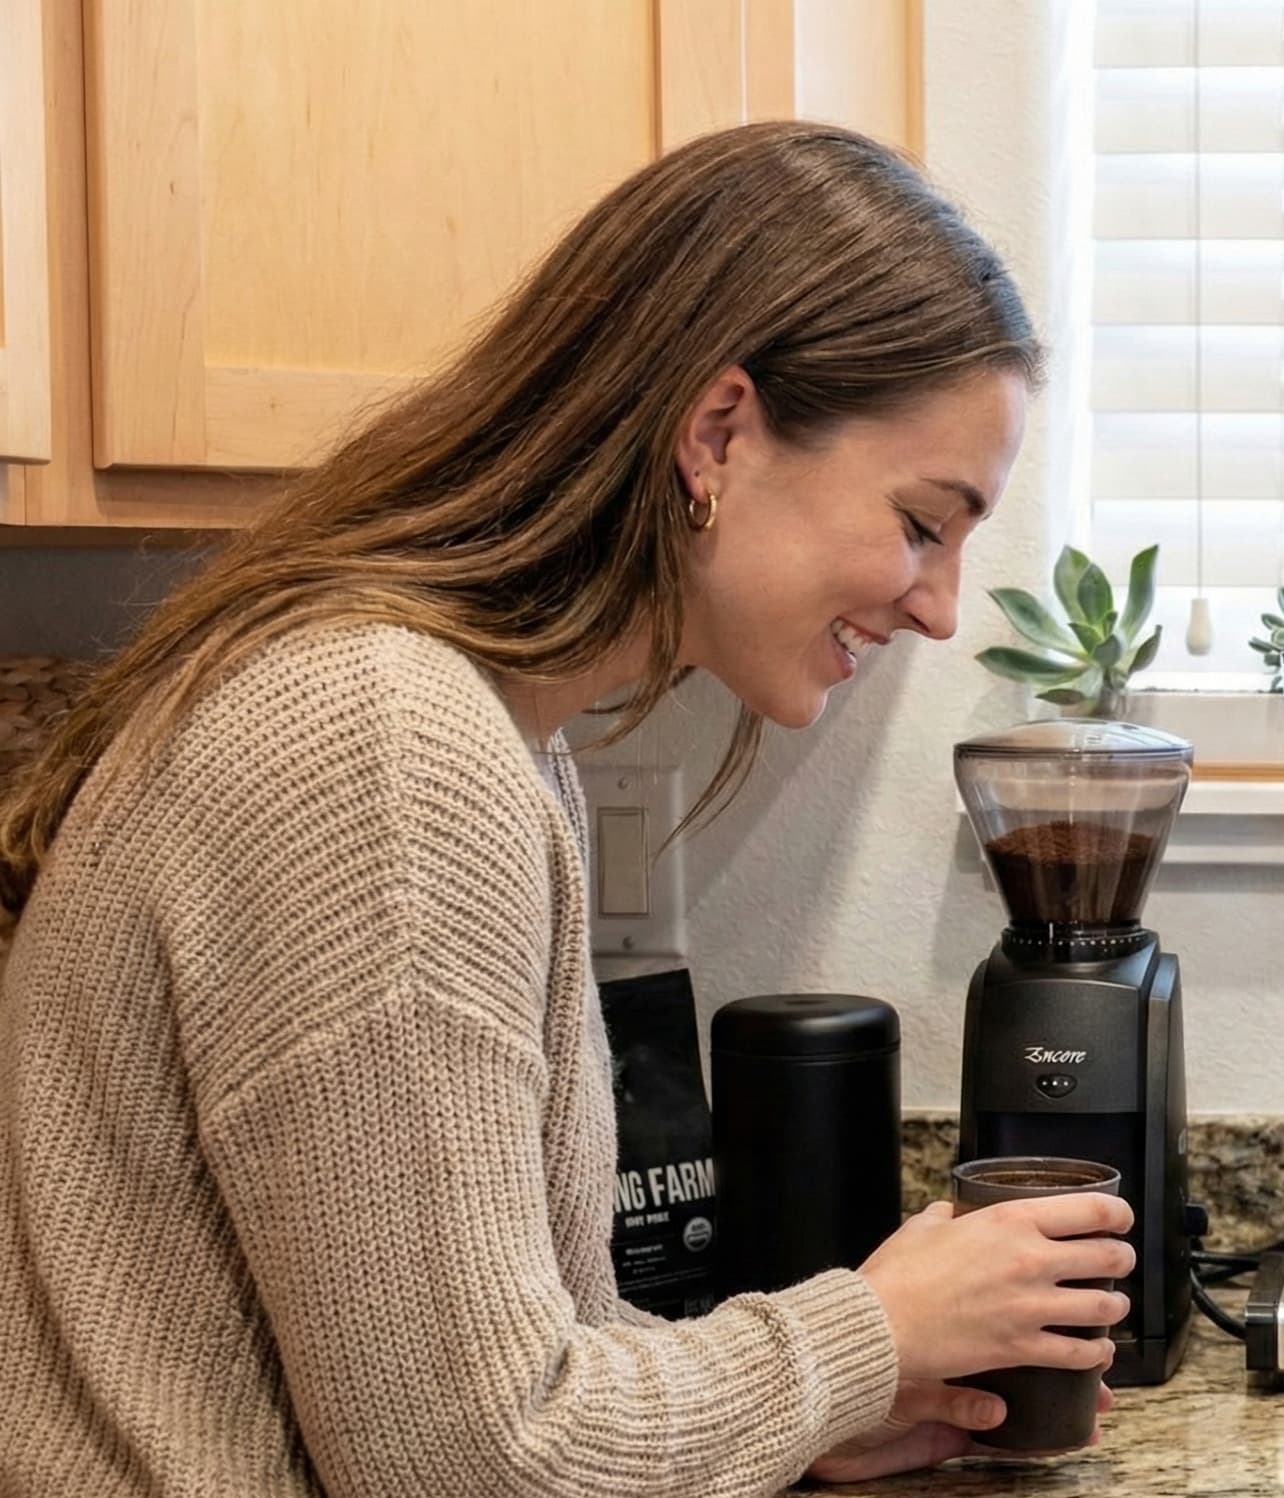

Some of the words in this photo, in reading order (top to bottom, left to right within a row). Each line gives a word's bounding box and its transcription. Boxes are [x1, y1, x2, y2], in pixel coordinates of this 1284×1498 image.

[1024, 1046, 1087, 1064] Encore
[614, 1169, 646, 1213] NG
[647, 1157, 716, 1207] FARM
